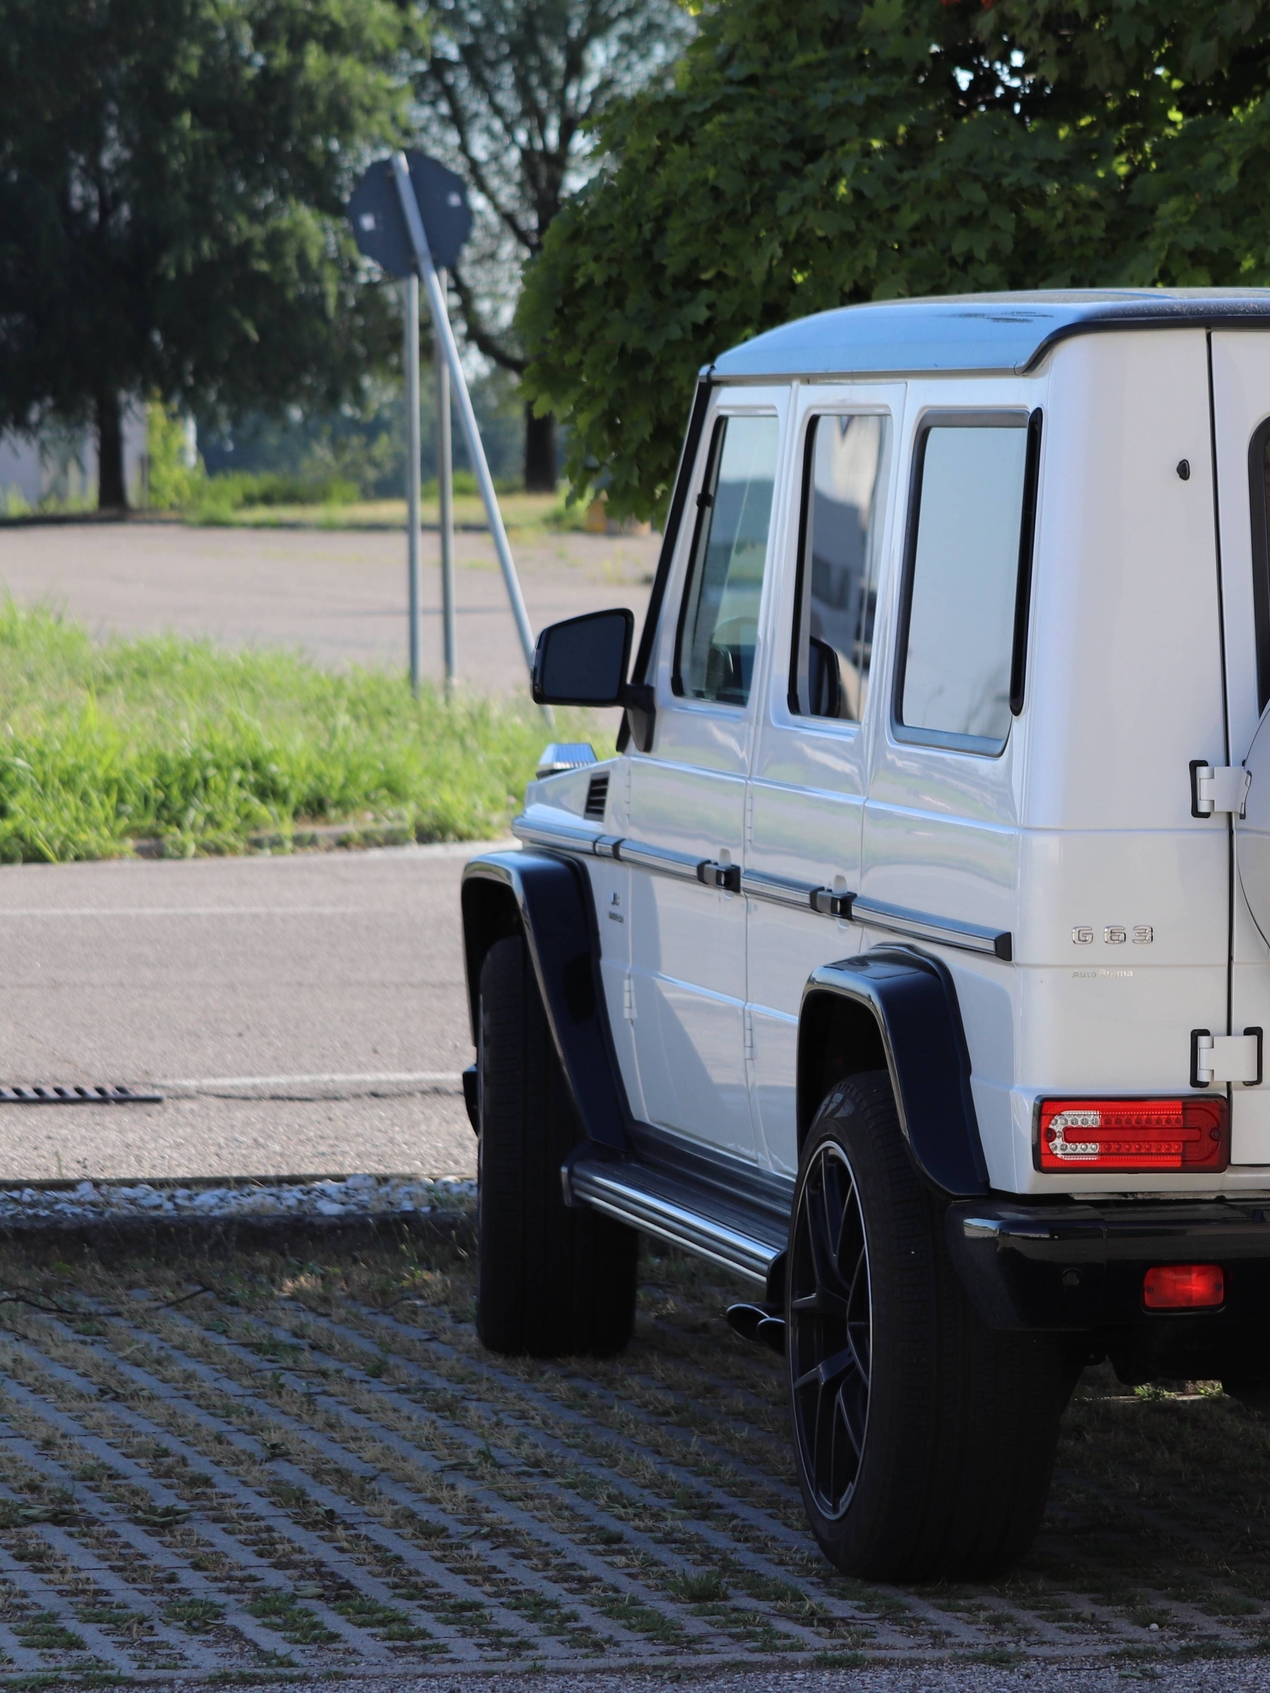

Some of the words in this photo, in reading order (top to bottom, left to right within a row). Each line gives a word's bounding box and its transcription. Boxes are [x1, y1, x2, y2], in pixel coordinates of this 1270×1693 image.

[1071, 925, 1094, 945] G
[1103, 924, 1154, 945] 63
[1072, 969, 1097, 979] Auto
